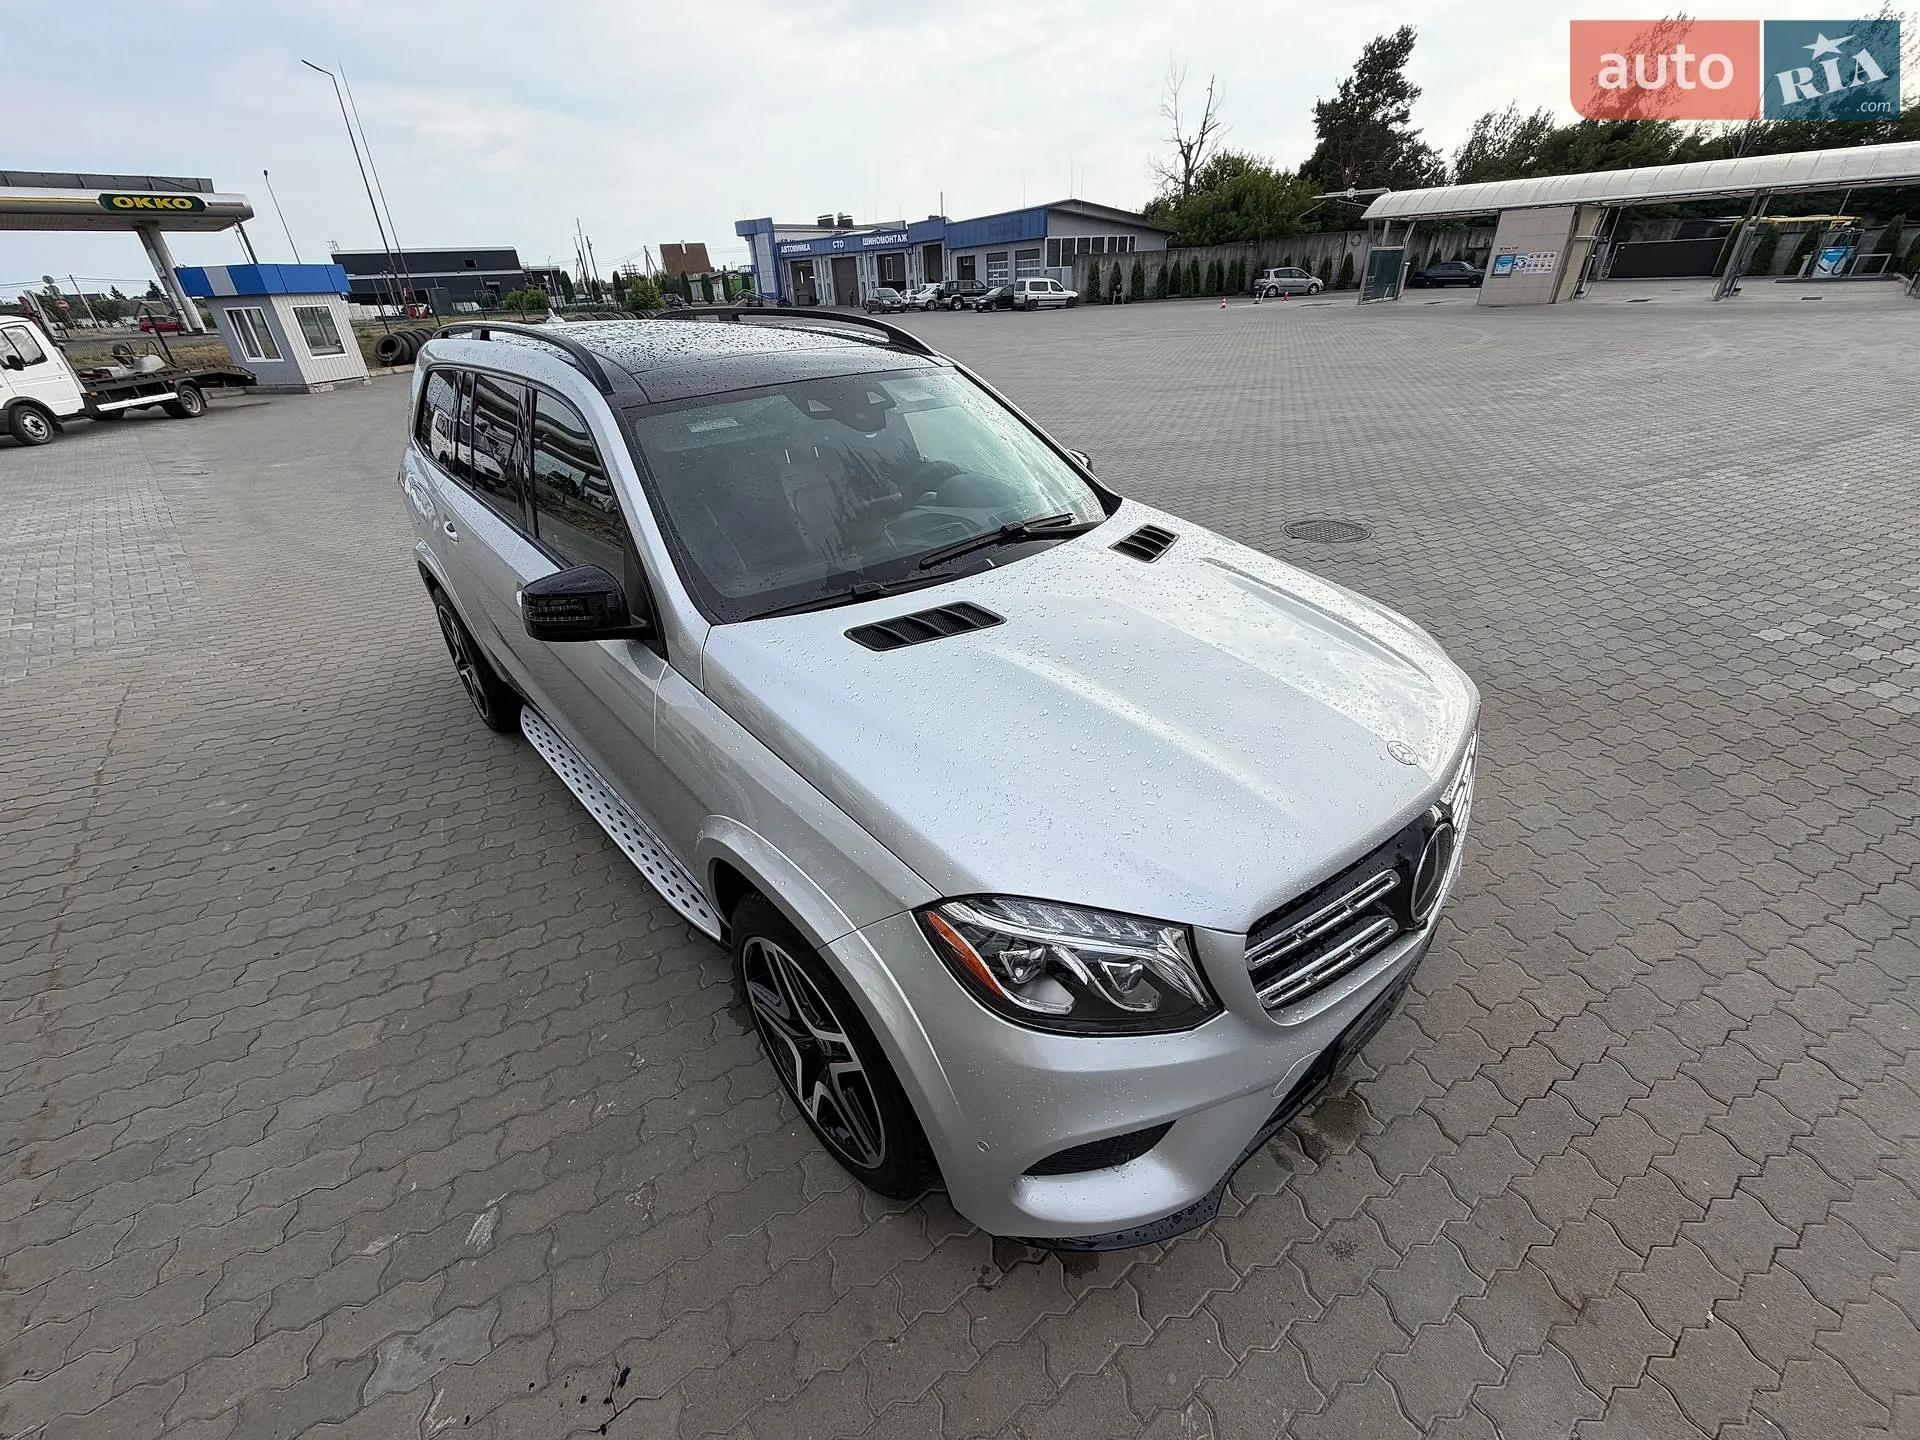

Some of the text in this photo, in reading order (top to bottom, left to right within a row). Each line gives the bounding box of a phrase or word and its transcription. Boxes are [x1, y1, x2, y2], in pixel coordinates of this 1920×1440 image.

[112, 196, 193, 209] OKKO
[832, 240, 844, 249] СТО
[862, 233, 908, 246] ШИНОМОНТАЖ
